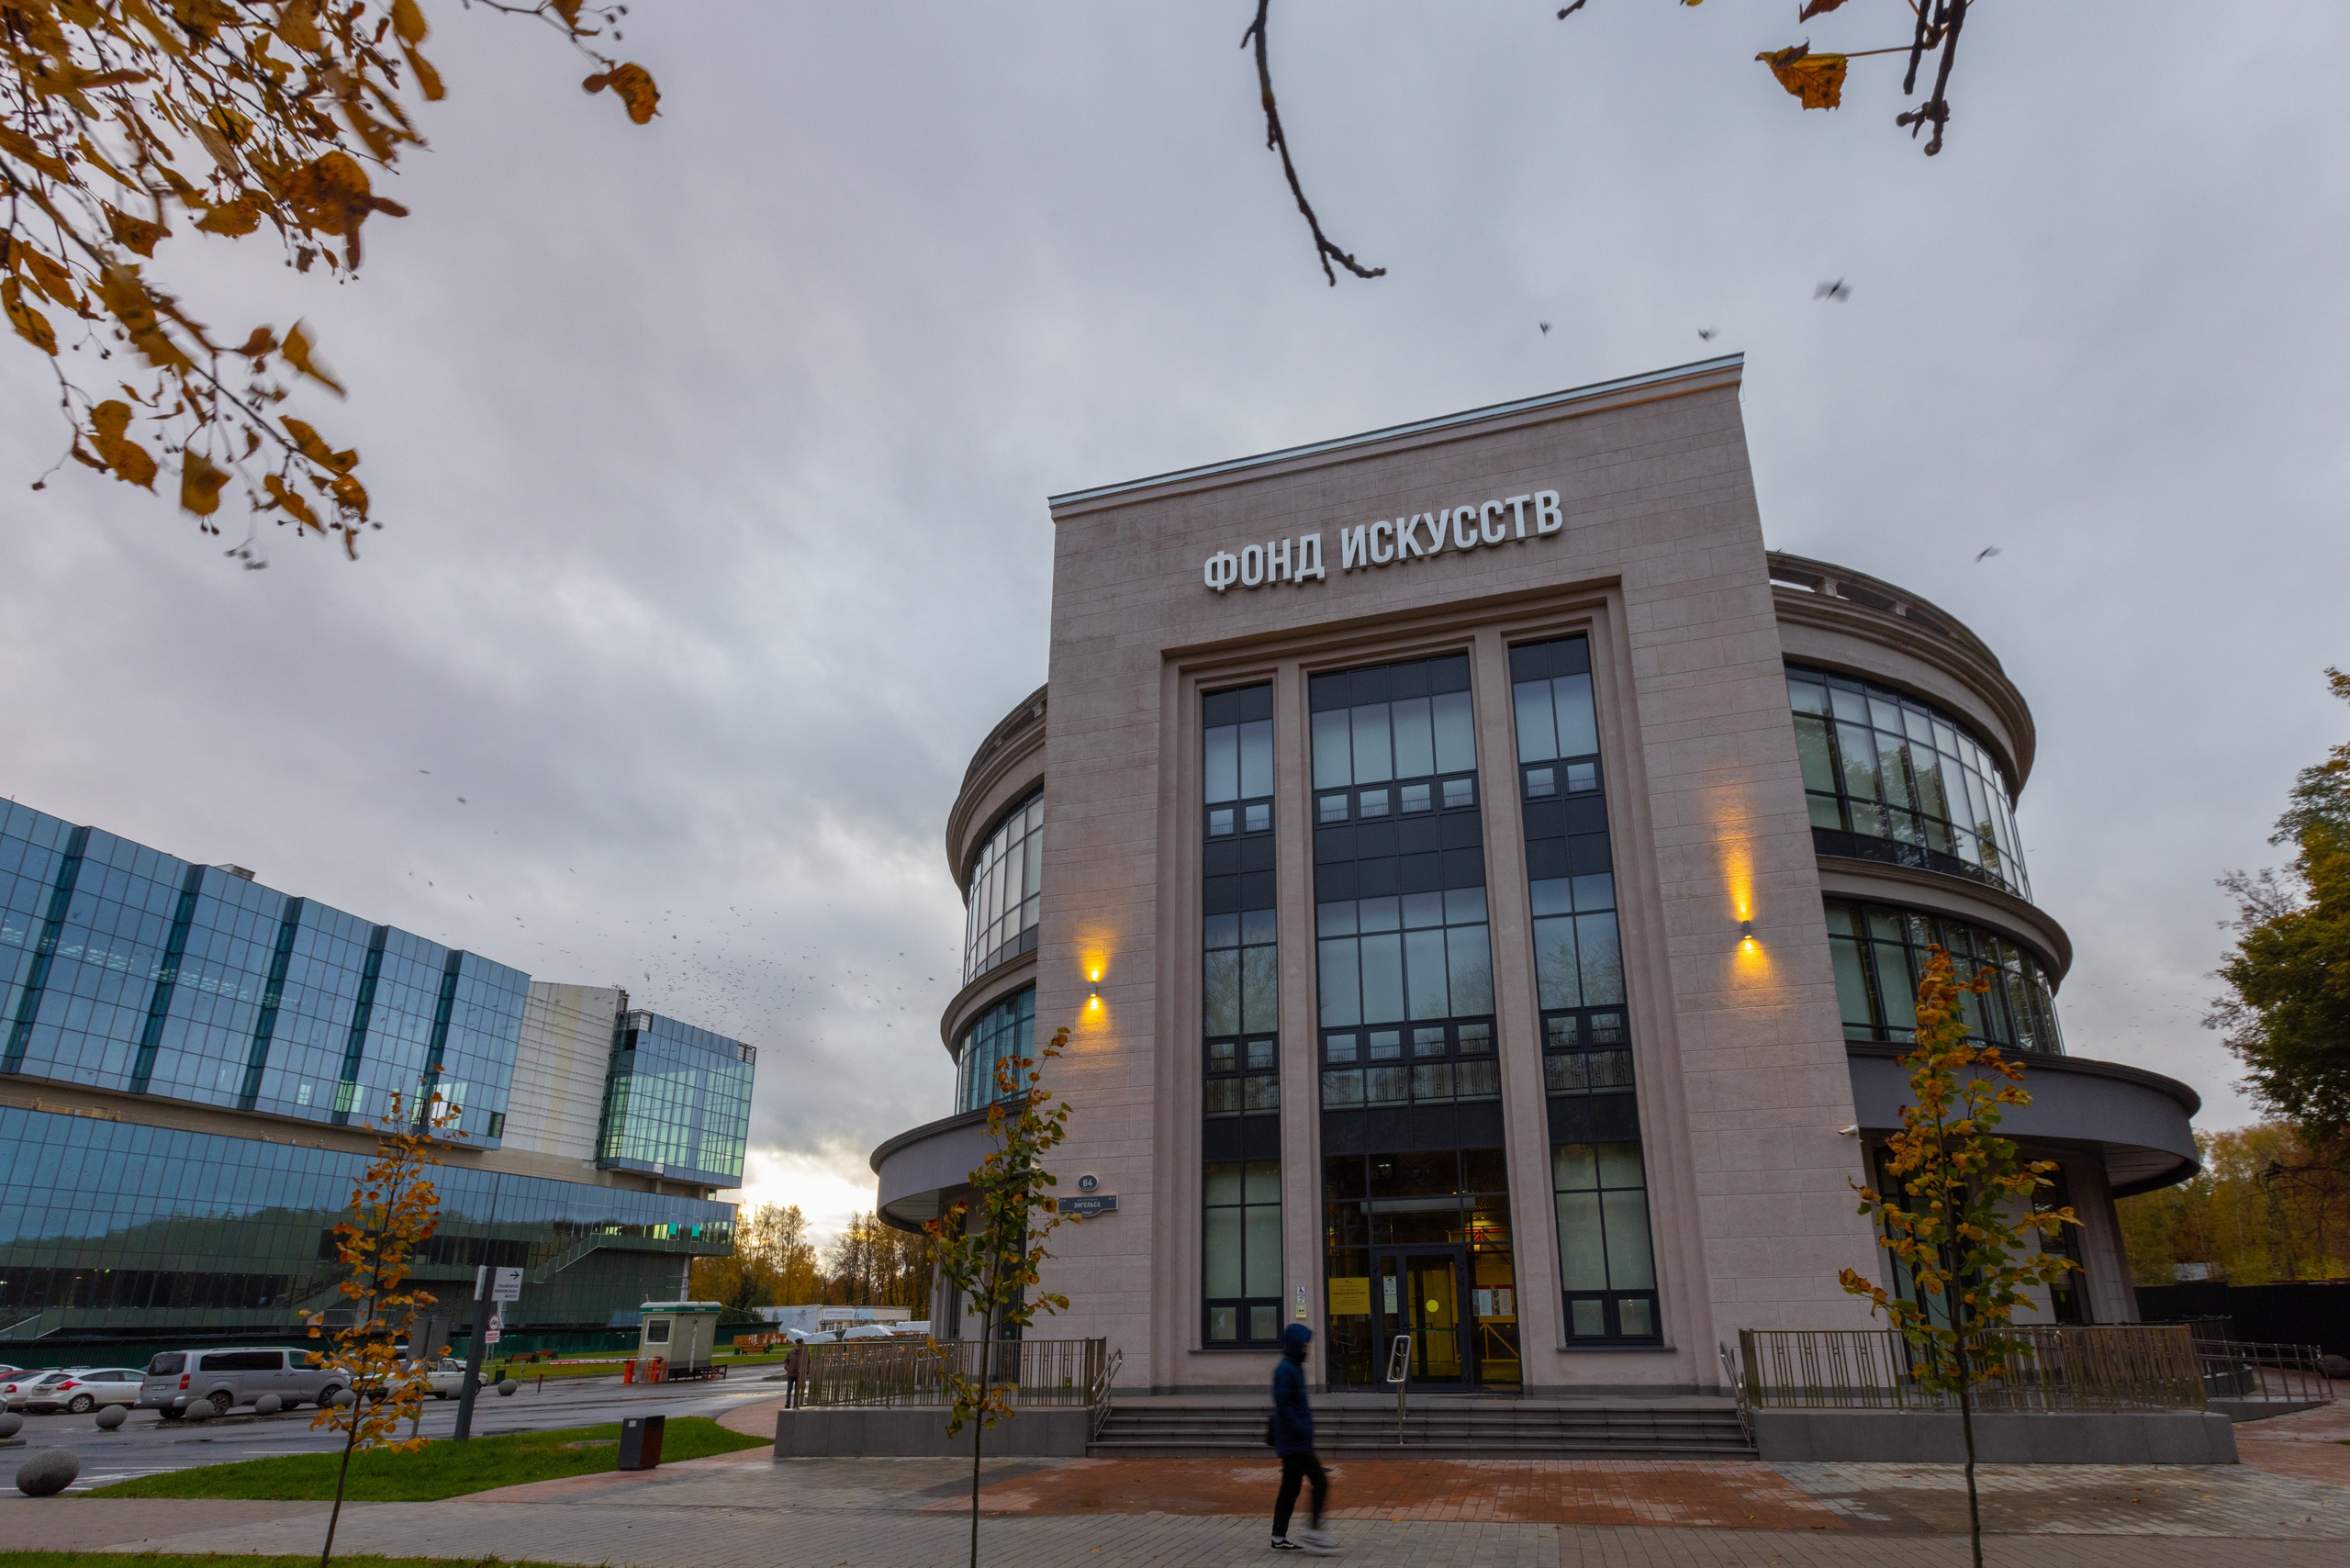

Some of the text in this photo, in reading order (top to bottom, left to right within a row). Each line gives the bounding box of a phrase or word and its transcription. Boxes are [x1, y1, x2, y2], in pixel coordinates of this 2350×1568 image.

[1204, 489, 1563, 592] ФОНД ИСКУССТВ
[1082, 1179, 1093, 1187] 64
